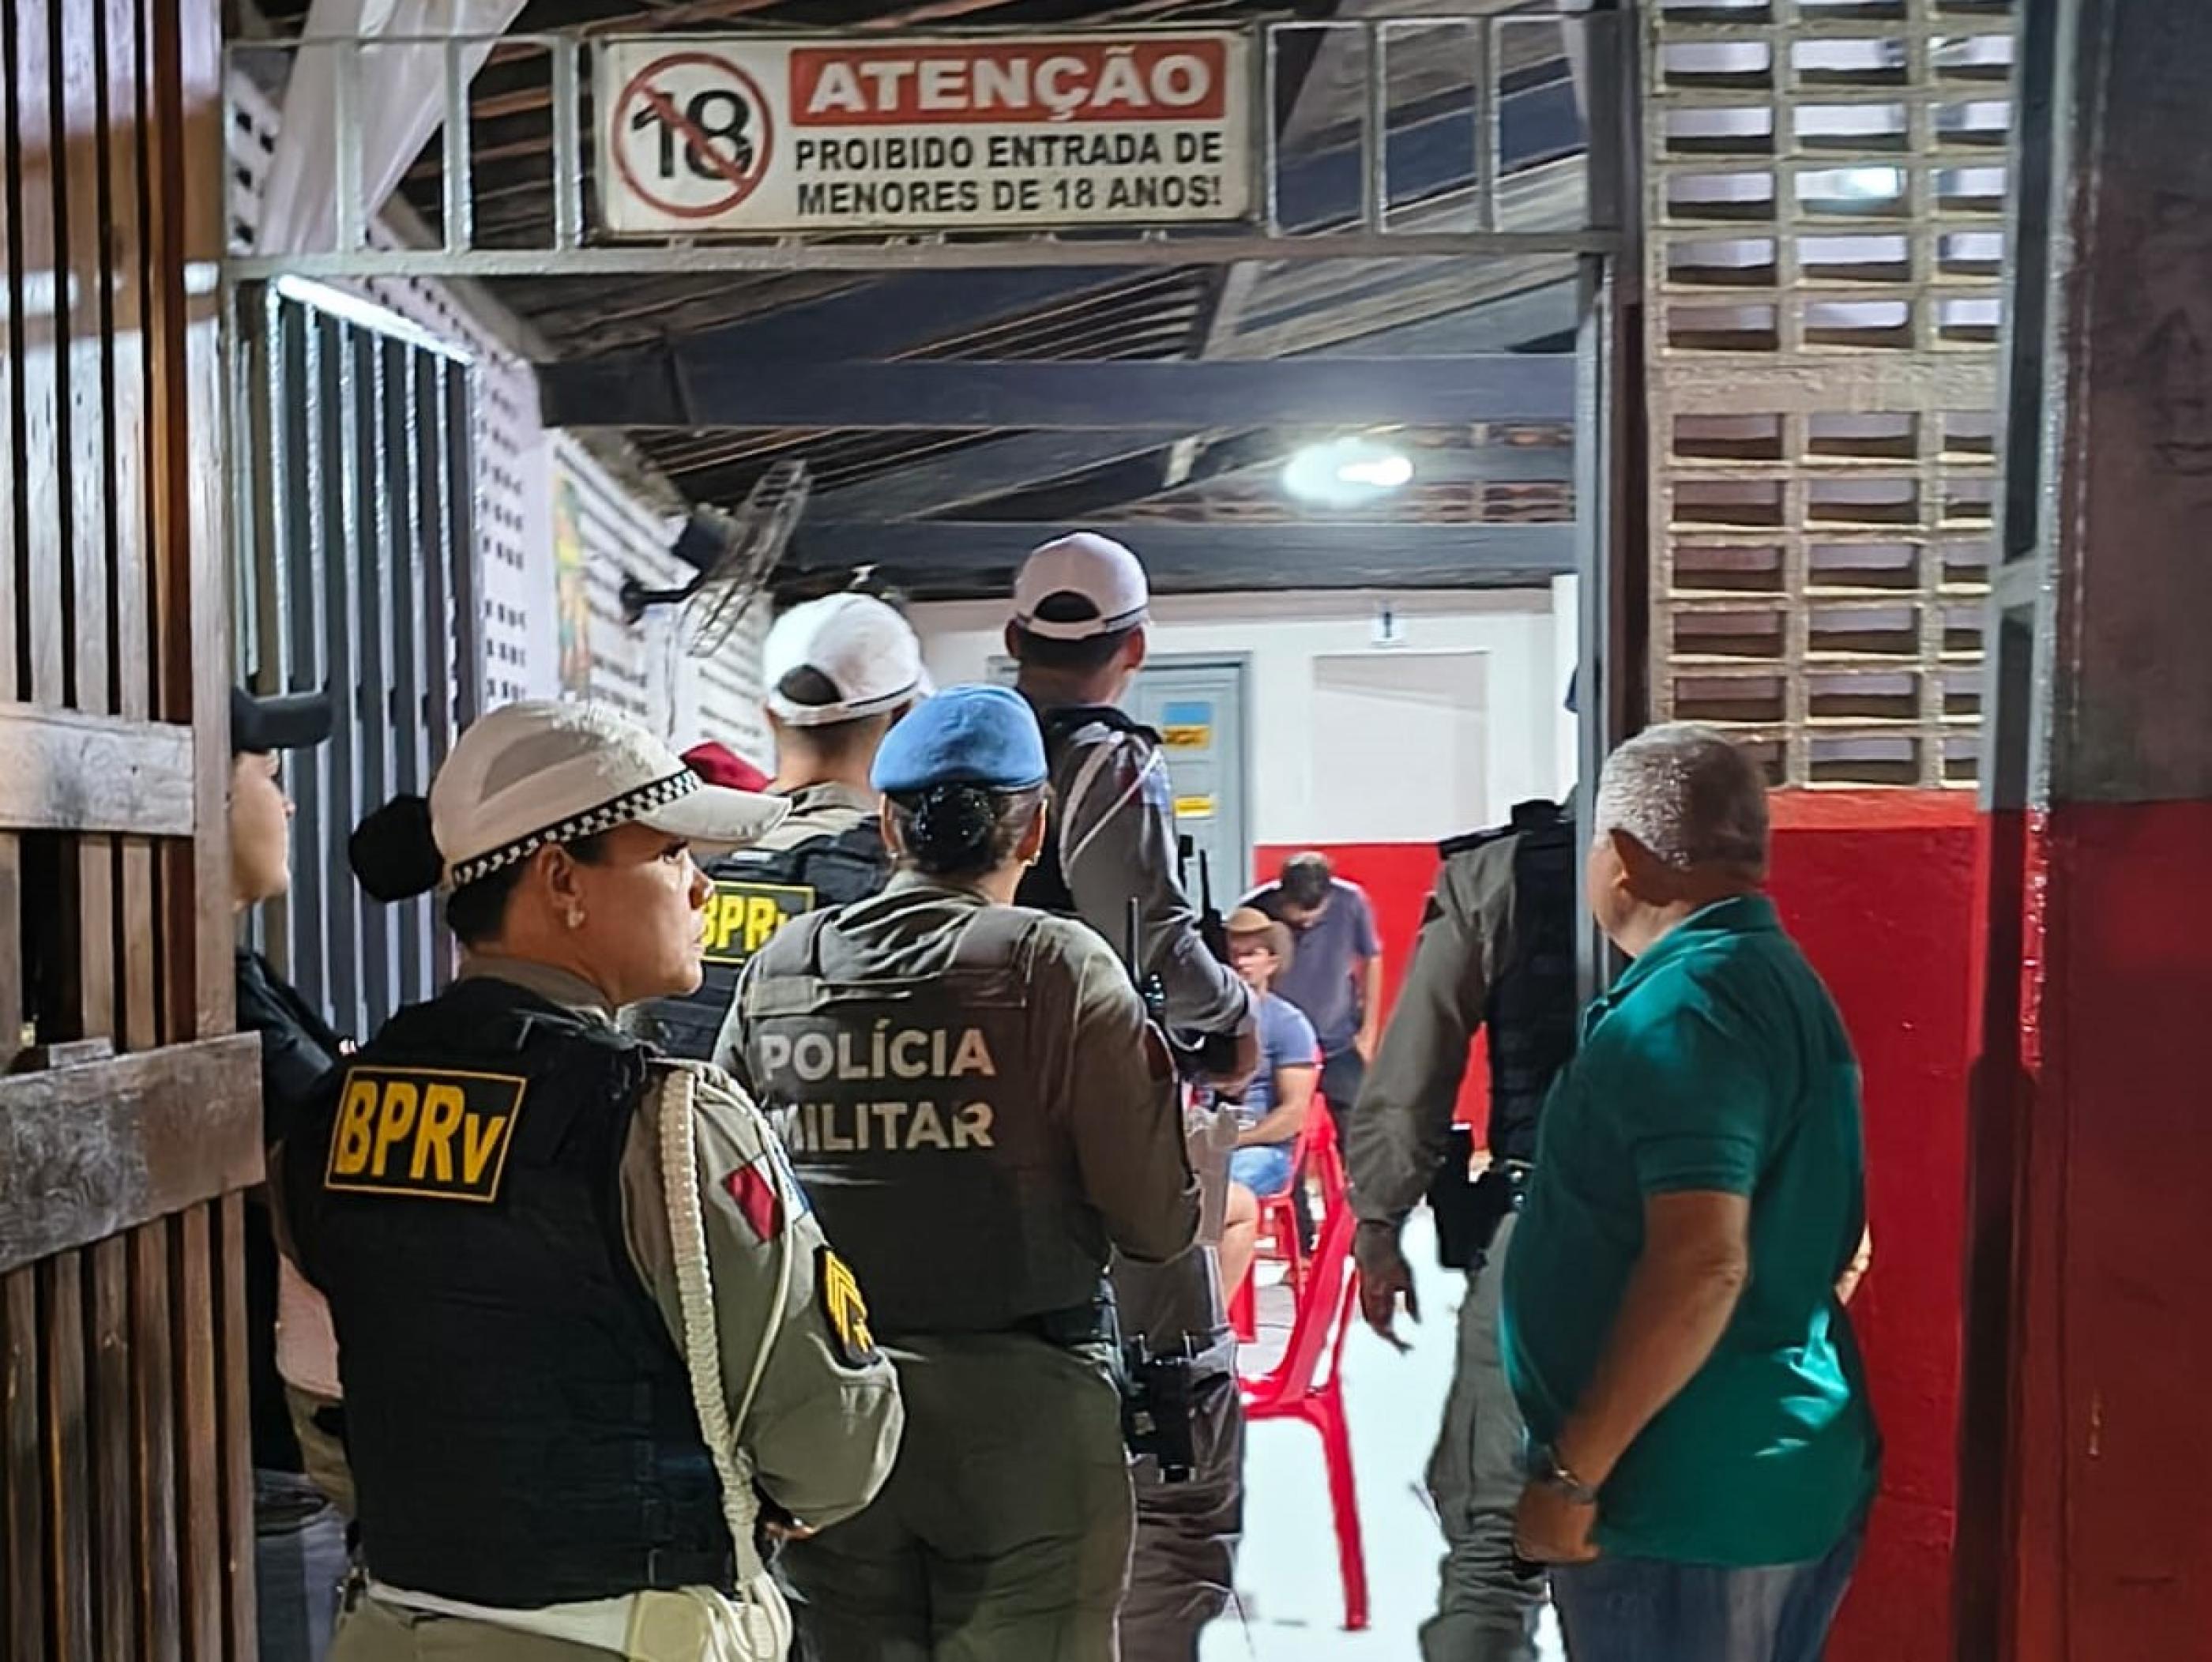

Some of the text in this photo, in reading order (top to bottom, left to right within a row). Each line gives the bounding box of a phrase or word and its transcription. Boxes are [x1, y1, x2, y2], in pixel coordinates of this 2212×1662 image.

[806, 44, 1210, 122] ATENÇÃO
[632, 89, 753, 180] 18
[795, 130, 1224, 172] PROIBIDO ENTRADA DE
[797, 174, 1223, 216] MENORES DE 18 ANOS!
[701, 893, 788, 952] BPR
[758, 1017, 998, 1081] POLÍCIA
[333, 1080, 507, 1183] BPRv
